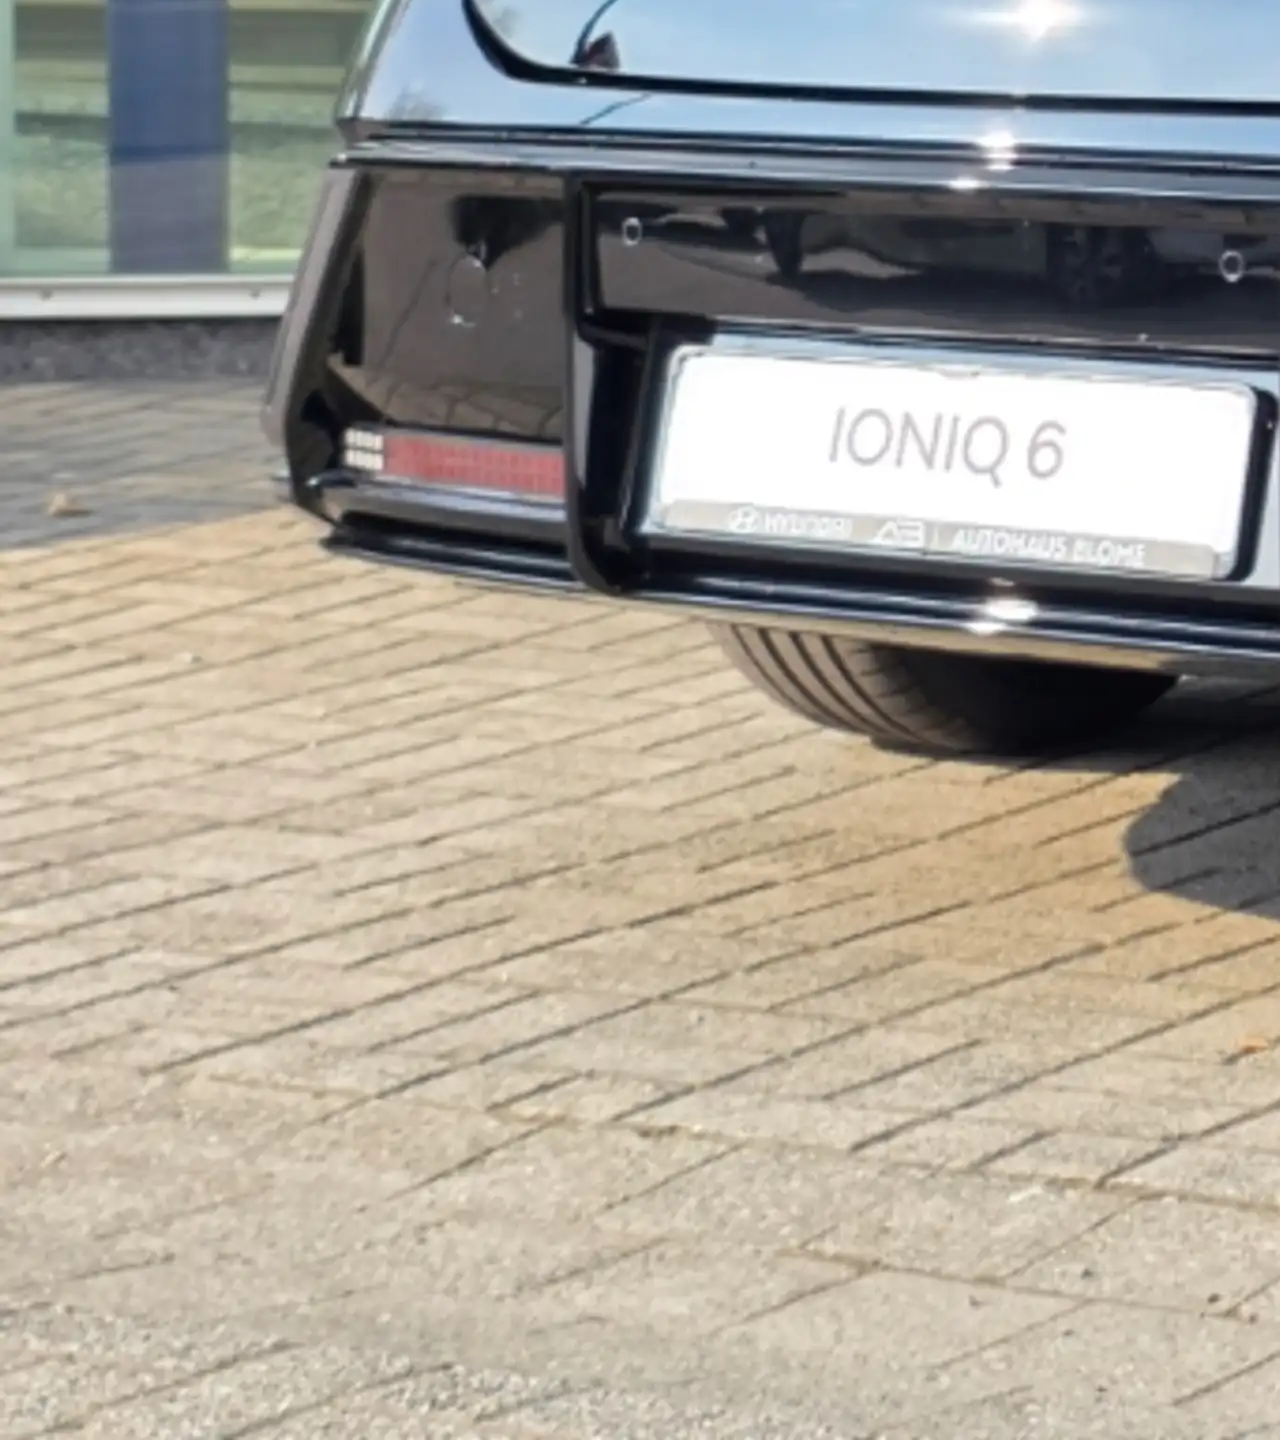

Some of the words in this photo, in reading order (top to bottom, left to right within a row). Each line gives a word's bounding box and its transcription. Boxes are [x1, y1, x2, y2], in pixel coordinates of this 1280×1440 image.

[829, 407, 1008, 489] IONIQ
[1027, 418, 1067, 480] 6
[952, 528, 1068, 559] AUTOHAUS
